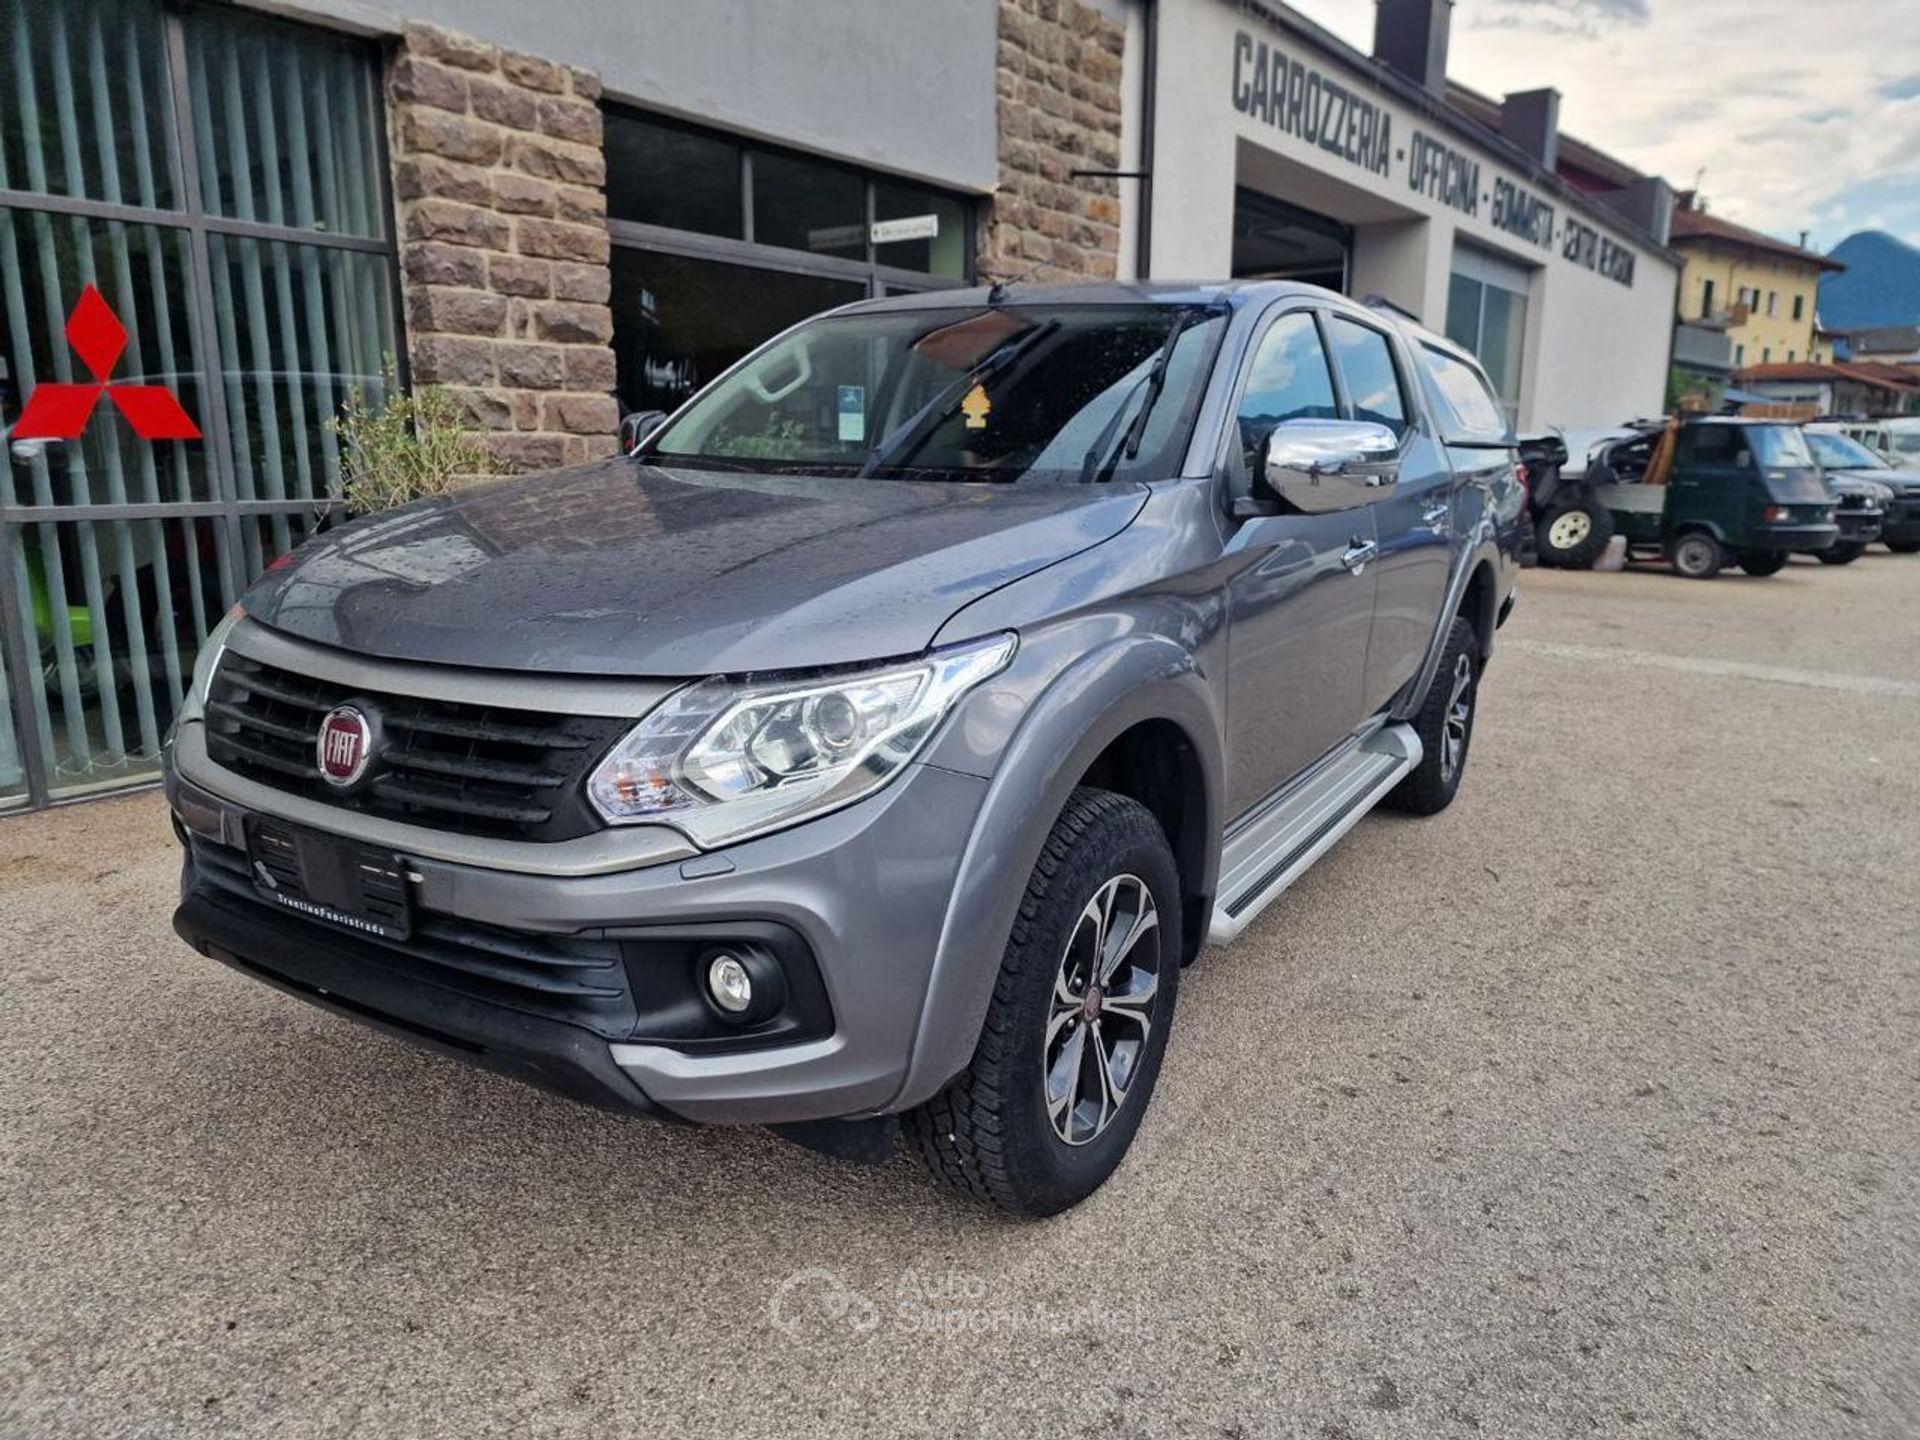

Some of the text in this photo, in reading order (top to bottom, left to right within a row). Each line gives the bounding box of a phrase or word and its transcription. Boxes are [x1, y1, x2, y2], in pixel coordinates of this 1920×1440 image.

[1233, 30, 1391, 178] CARROZZERIA
[1409, 130, 1479, 218] OFFICINA
[326, 728, 359, 767] FIAT
